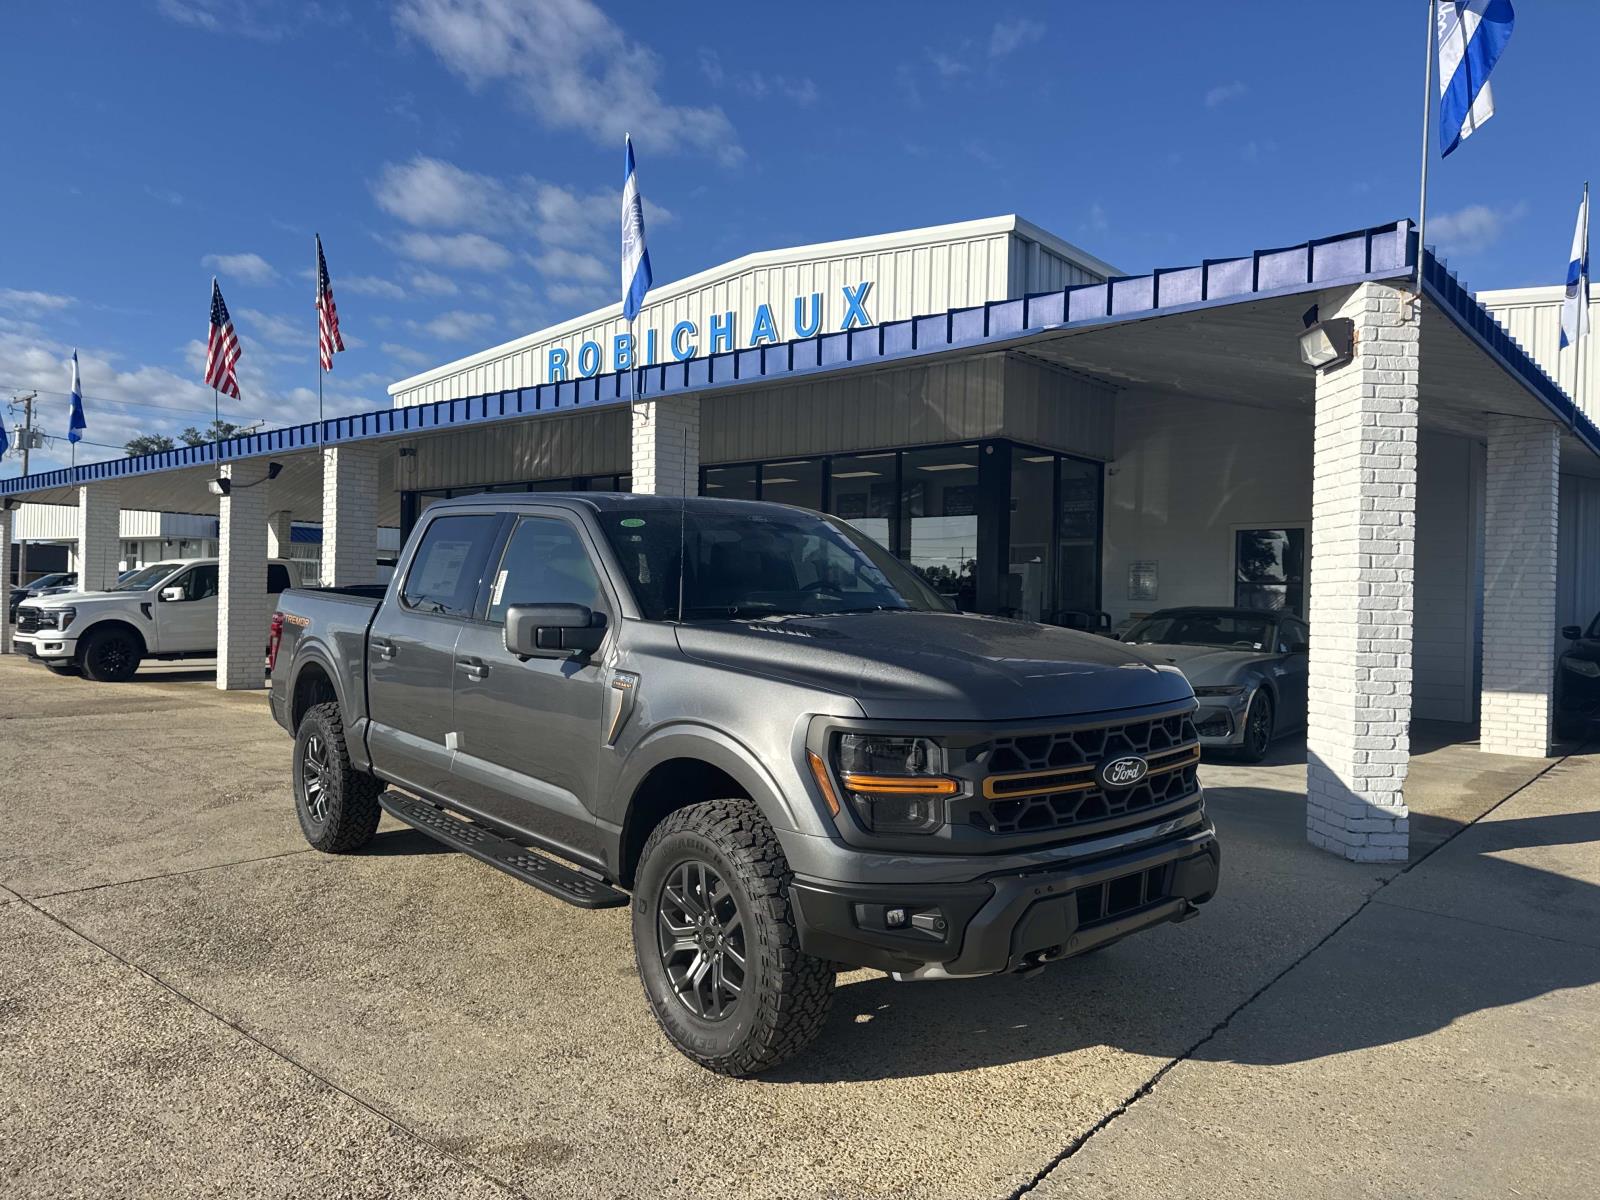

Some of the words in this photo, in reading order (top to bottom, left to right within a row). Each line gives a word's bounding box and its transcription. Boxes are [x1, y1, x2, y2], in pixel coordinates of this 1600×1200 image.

[548, 281, 872, 384] ROBICHAUX
[285, 613, 311, 627] TREMOR
[1112, 761, 1139, 782] Ford
